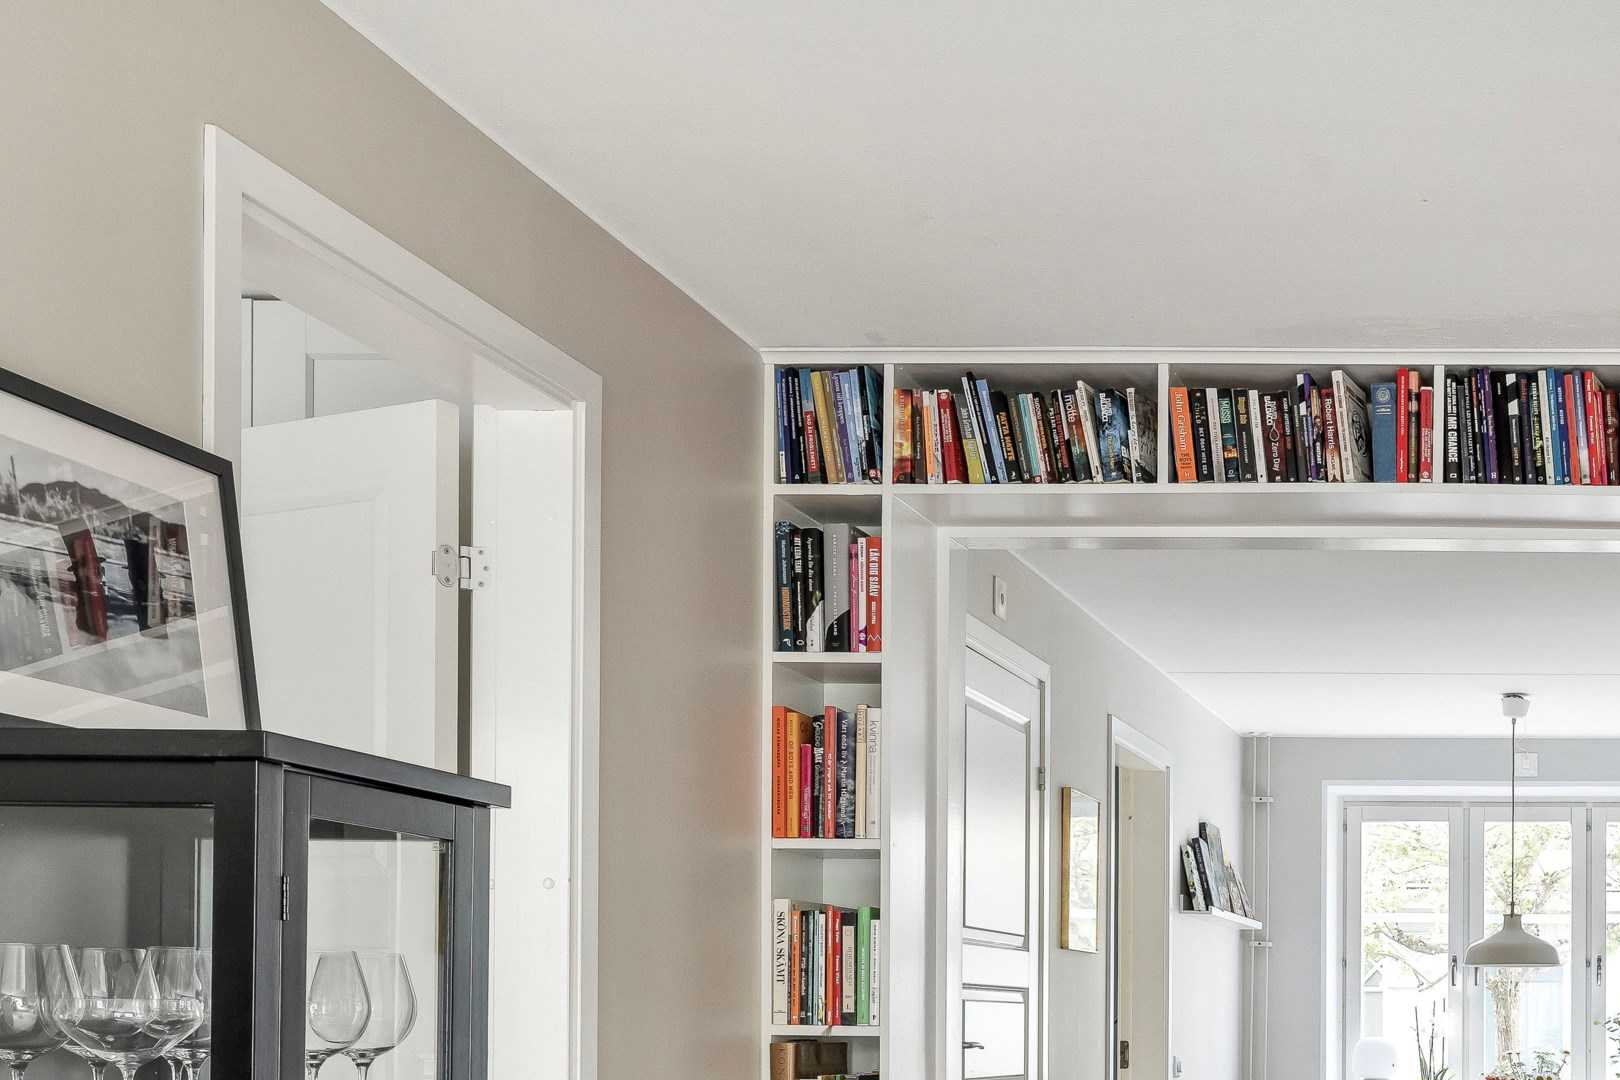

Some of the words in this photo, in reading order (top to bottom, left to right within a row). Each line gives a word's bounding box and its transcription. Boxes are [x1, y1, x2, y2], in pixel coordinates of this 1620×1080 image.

[960, 407, 968, 419] John
[1034, 397, 1042, 420] SUDOKU
[1174, 391, 1183, 413] John
[1324, 399, 1334, 425] Robert
[963, 419, 973, 438] Grisham
[1177, 415, 1187, 451] Grisham
[1448, 416, 1457, 430] MR
[999, 412, 1009, 435] FATTA
[1004, 437, 1015, 461] MATTE
[1327, 425, 1336, 450] Harris
[1448, 431, 1458, 462] CHANCE
[869, 548, 880, 561] LÄK
[869, 562, 878, 575] DIG
[869, 576, 879, 597] SJÄLV
[868, 720, 880, 753] kvinna
[840, 788, 848, 818] Hägglund
[776, 911, 787, 944] SKÖNA
[776, 948, 787, 984] SKÄMT
